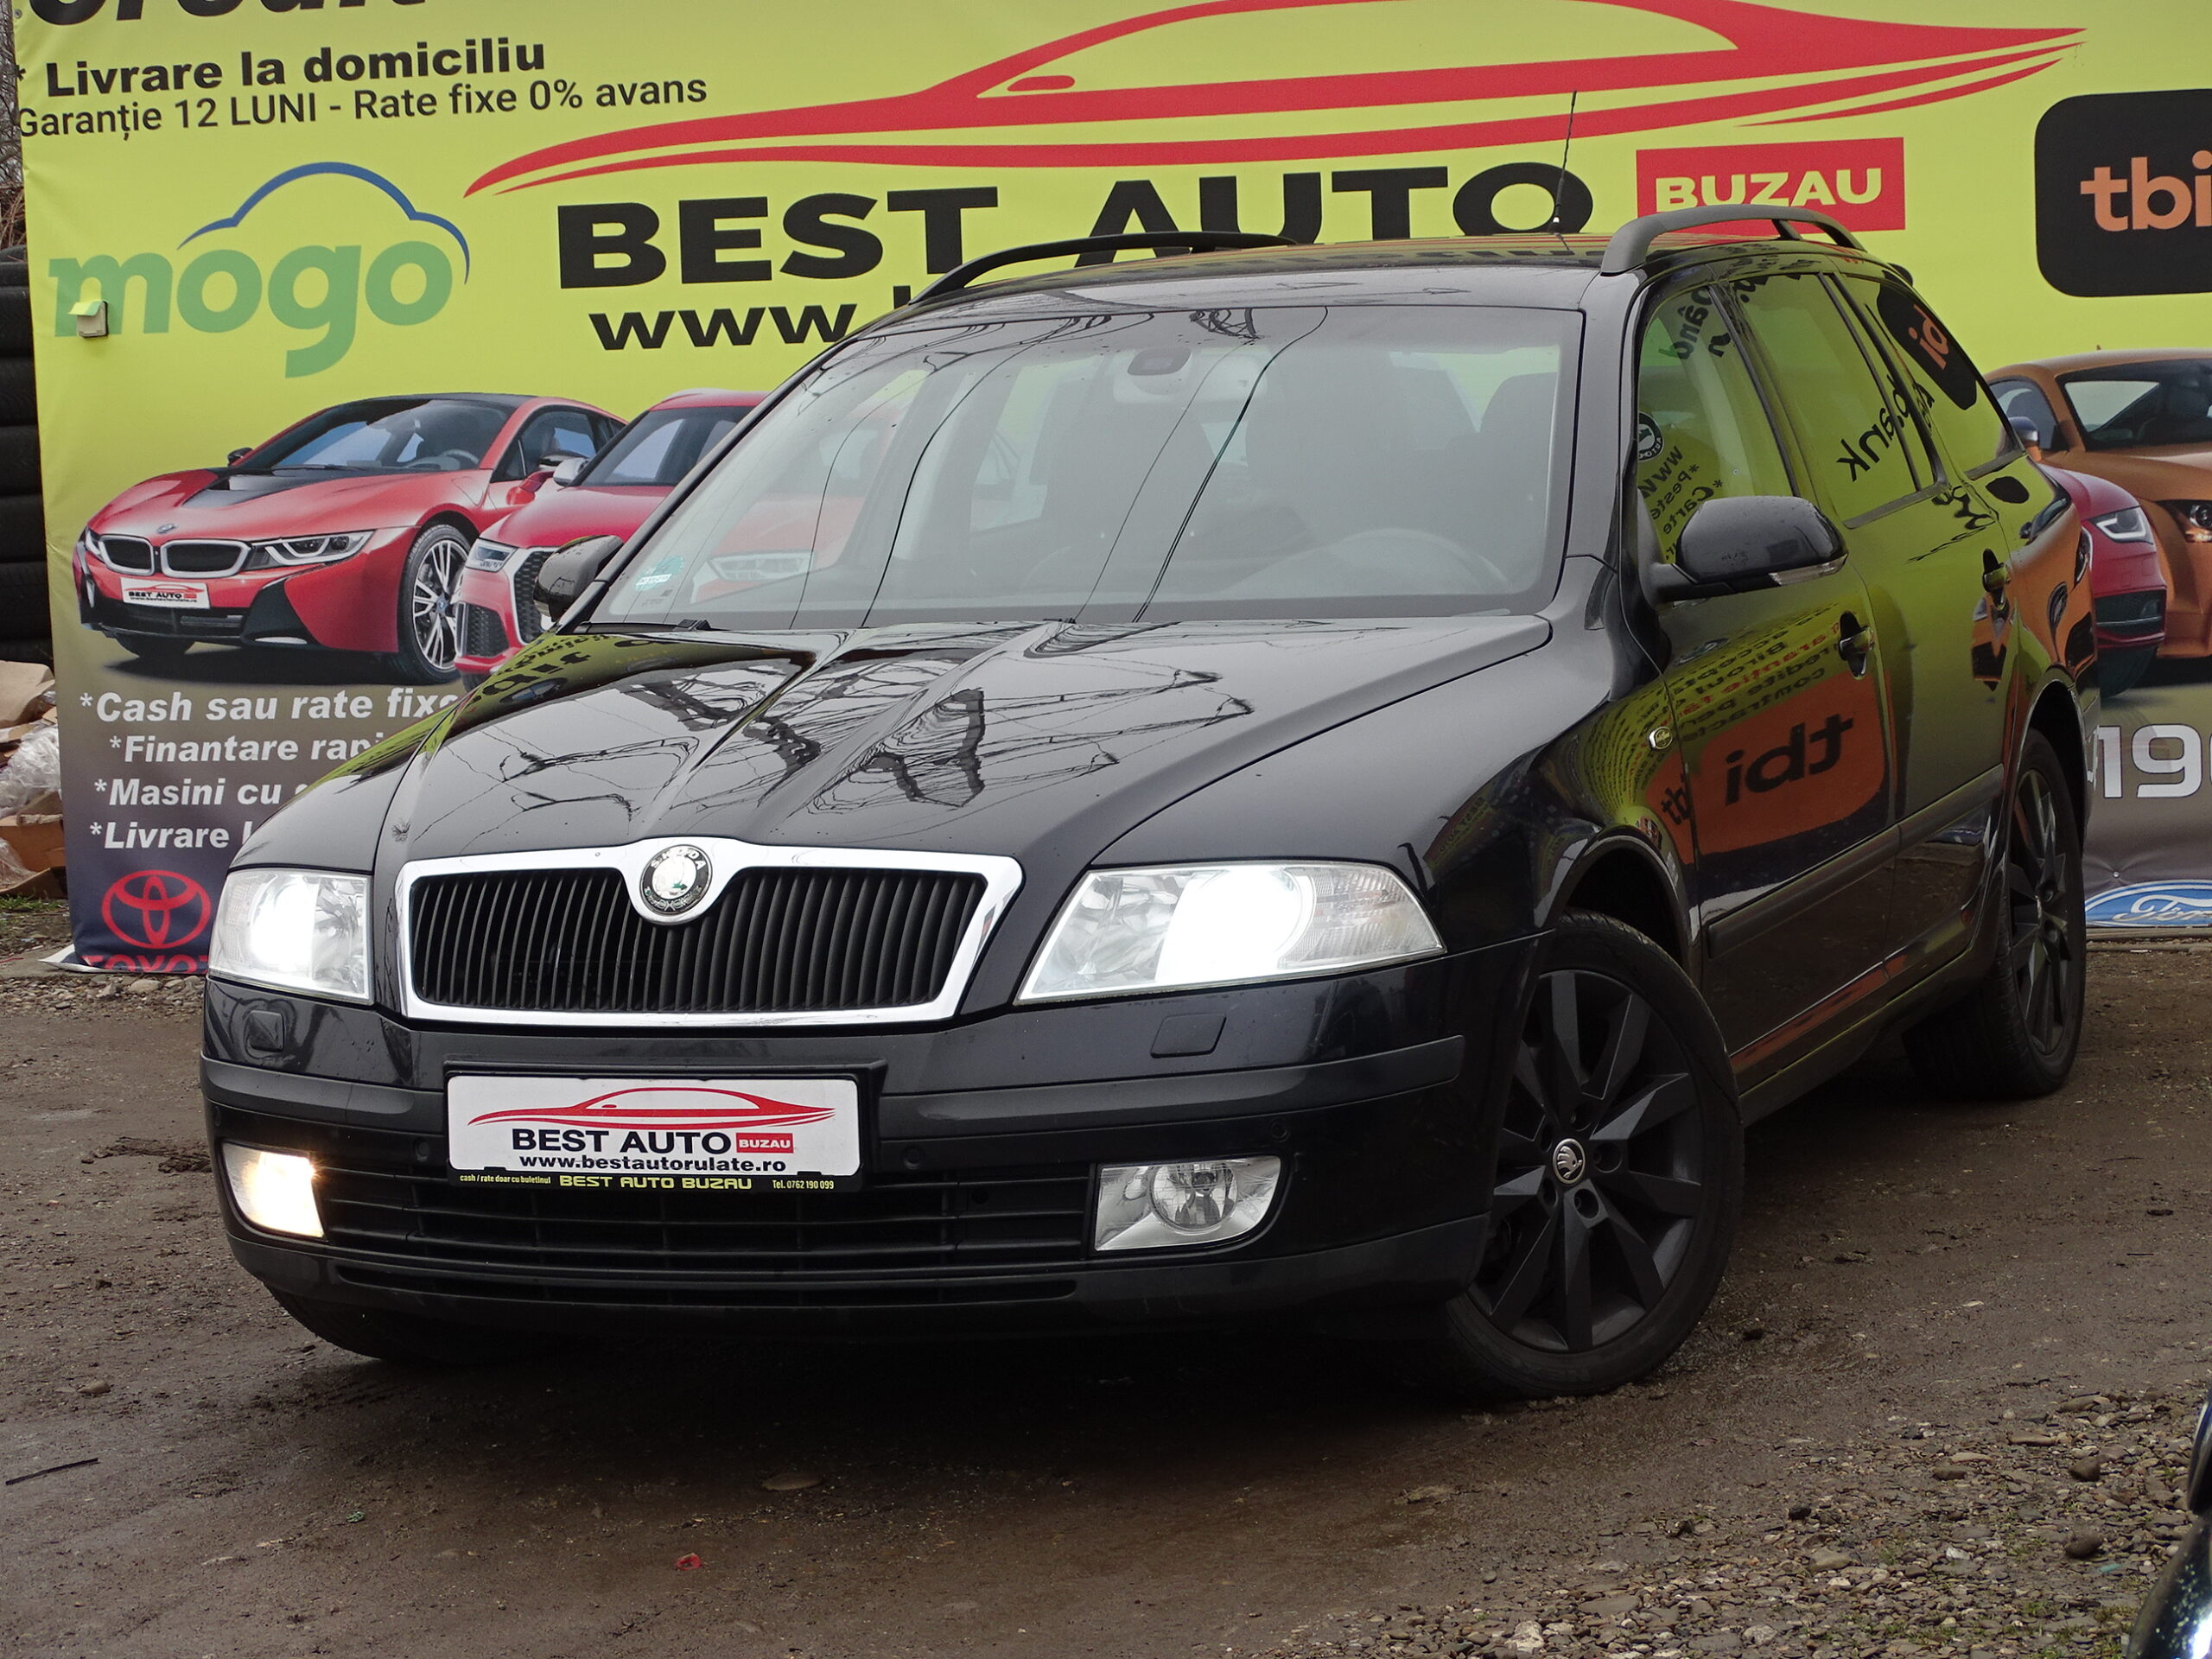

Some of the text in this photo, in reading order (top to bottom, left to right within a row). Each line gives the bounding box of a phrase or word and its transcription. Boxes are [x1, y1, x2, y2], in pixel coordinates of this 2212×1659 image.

[46, 38, 546, 97] Livrare la domiciliu
[175, 98, 219, 129] 12
[231, 92, 317, 126] LUNI
[354, 88, 437, 119] Rate
[449, 82, 517, 114] fixe
[530, 79, 583, 111] 0%
[596, 78, 708, 107] avans
[1656, 168, 1883, 213] BUZAU
[2081, 150, 2212, 232] tbi
[557, 162, 1593, 289] BEST AUTO
[48, 240, 453, 378] mogo
[206, 696, 277, 721] sau
[291, 690, 372, 720] rate
[2099, 723, 2212, 798] 19
[237, 784, 282, 805] cu
[512, 1128, 791, 1154] BEST AUTO BUZAU
[495, 1175, 511, 1184] doar
[520, 1176, 551, 1185] buletinul
[519, 1154, 785, 1173] www.bestautorulate.ro
[559, 1175, 752, 1190] BEST AUTO BUZAU
[772, 1179, 834, 1190] Tel. 0762 190 099
